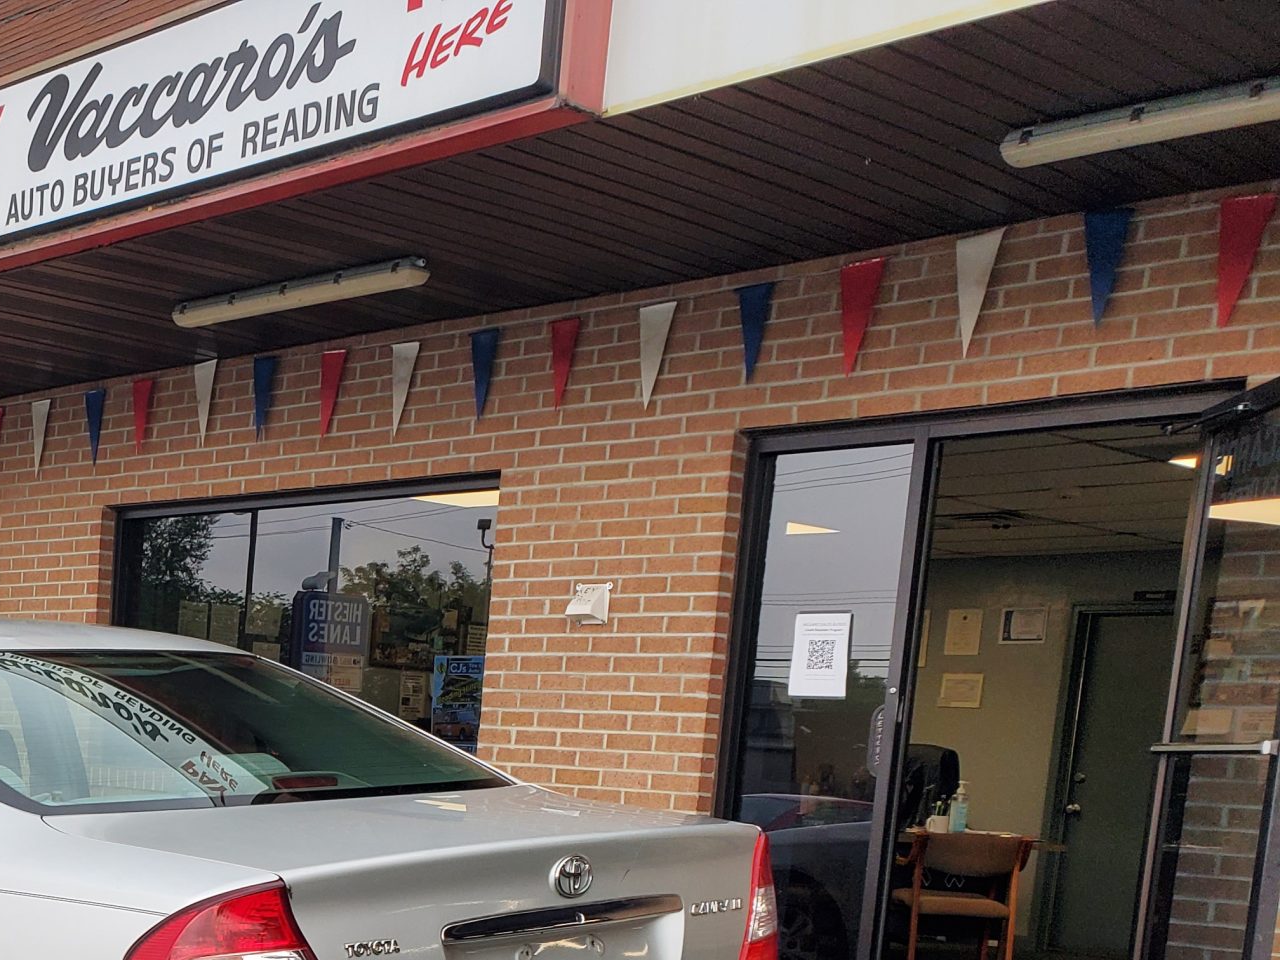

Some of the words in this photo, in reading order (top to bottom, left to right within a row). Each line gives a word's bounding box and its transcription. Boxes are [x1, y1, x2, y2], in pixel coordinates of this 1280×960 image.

[27, 1, 357, 173] Vaccaro's
[400, 0, 513, 87] HERE
[5, 179, 65, 226] AUTO
[72, 146, 177, 207] BUYERS
[187, 131, 224, 174] OF
[241, 82, 380, 158] READING
[344, 939, 401, 958] TOYOTA
